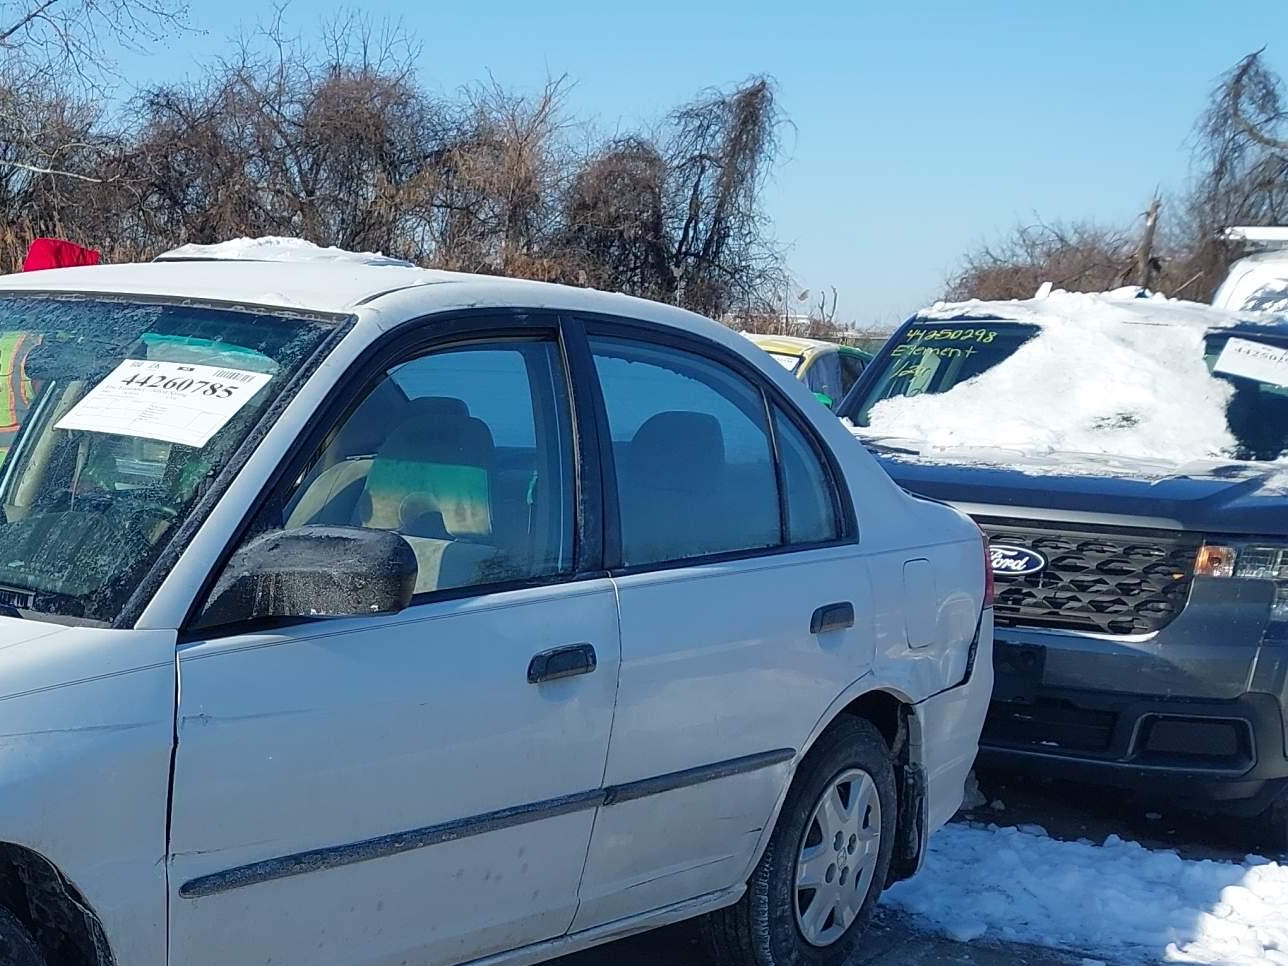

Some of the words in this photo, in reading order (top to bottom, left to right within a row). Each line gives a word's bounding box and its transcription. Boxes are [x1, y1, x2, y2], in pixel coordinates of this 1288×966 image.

[906, 328, 998, 343] 44250298
[890, 344, 977, 358] Element
[121, 373, 238, 399] 44260785
